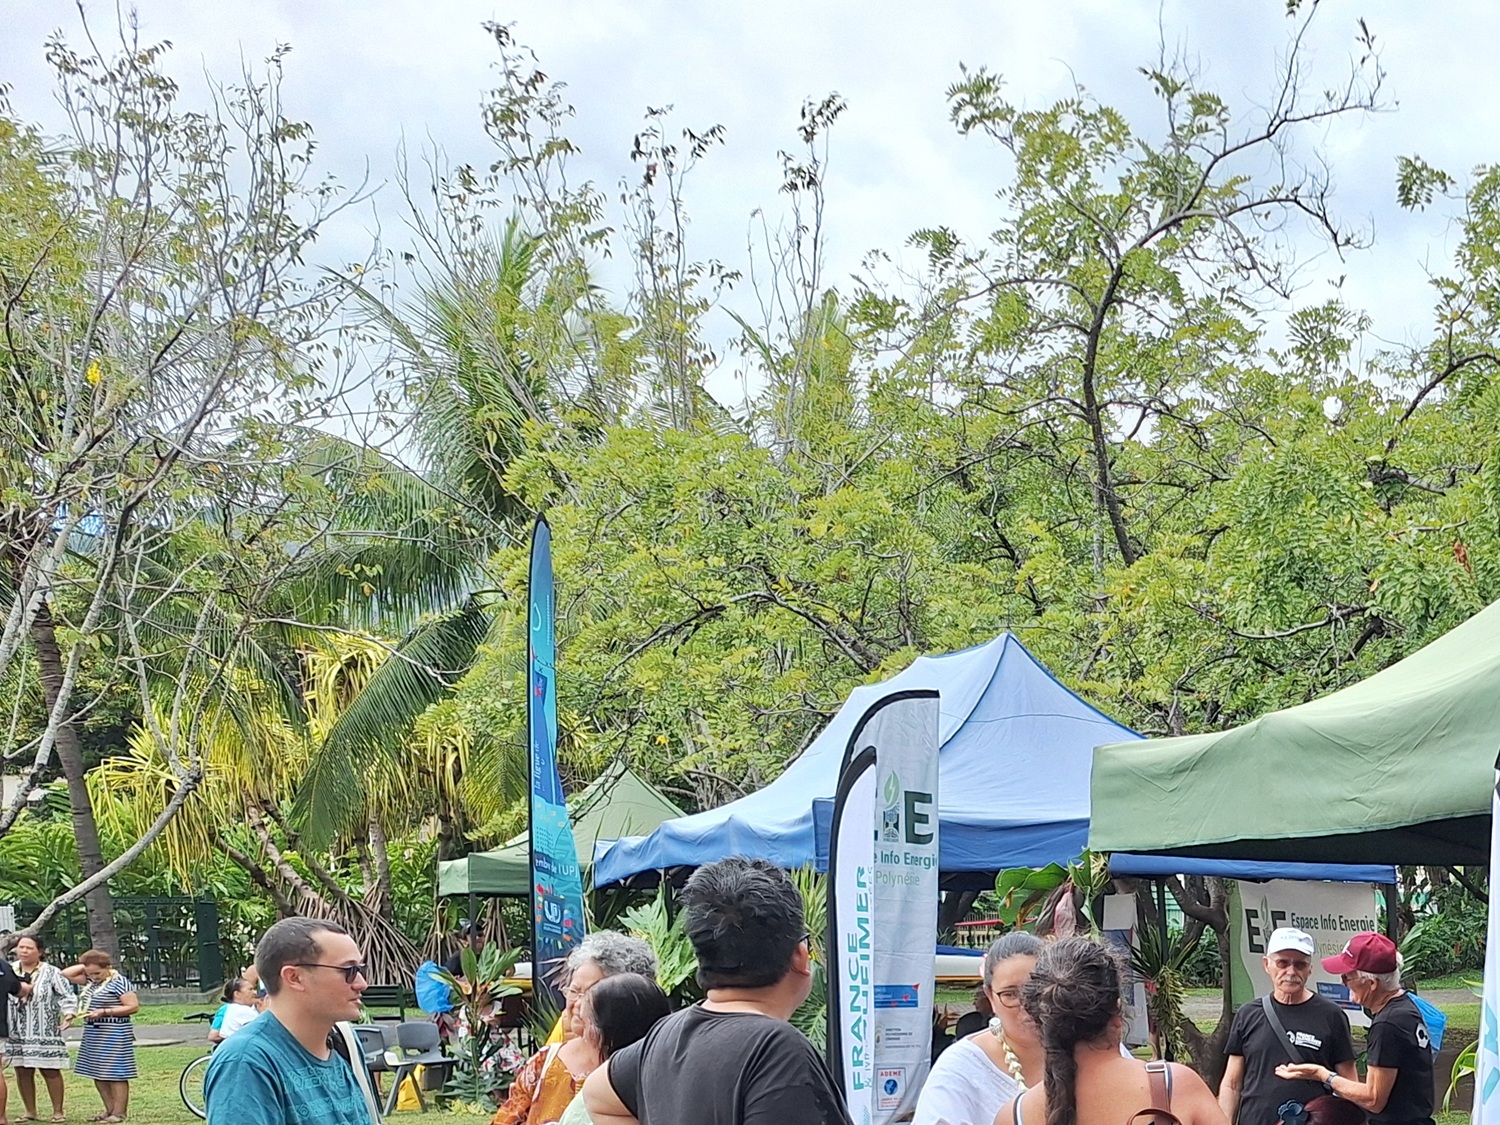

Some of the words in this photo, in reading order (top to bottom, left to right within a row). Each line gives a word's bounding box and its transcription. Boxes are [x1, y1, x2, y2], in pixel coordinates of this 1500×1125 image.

[880, 850, 900, 865] Info
[875, 870, 920, 887] Polynésie
[1291, 912, 1319, 930] Espace
[1320, 913, 1338, 931] Info
[1338, 915, 1375, 932] Energie
[847, 932, 864, 1091] FRANCE
